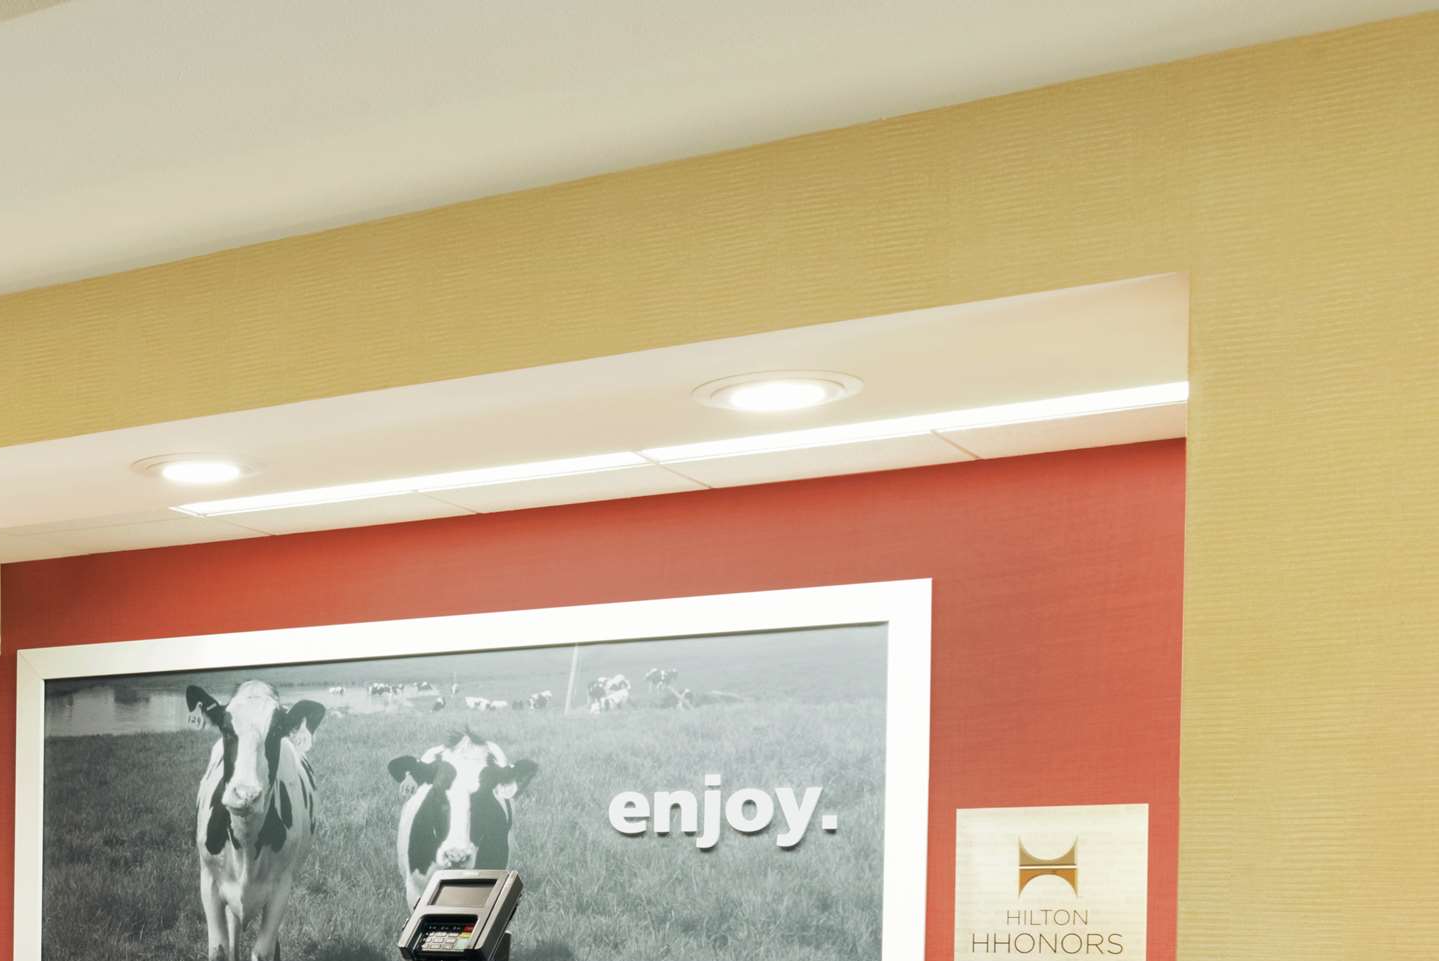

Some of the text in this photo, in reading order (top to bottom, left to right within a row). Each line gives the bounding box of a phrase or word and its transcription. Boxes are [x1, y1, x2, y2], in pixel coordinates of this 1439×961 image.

[608, 774, 838, 850] enjoy.
[1006, 909, 1088, 926] HILTON
[971, 932, 1124, 955] HHONORS
